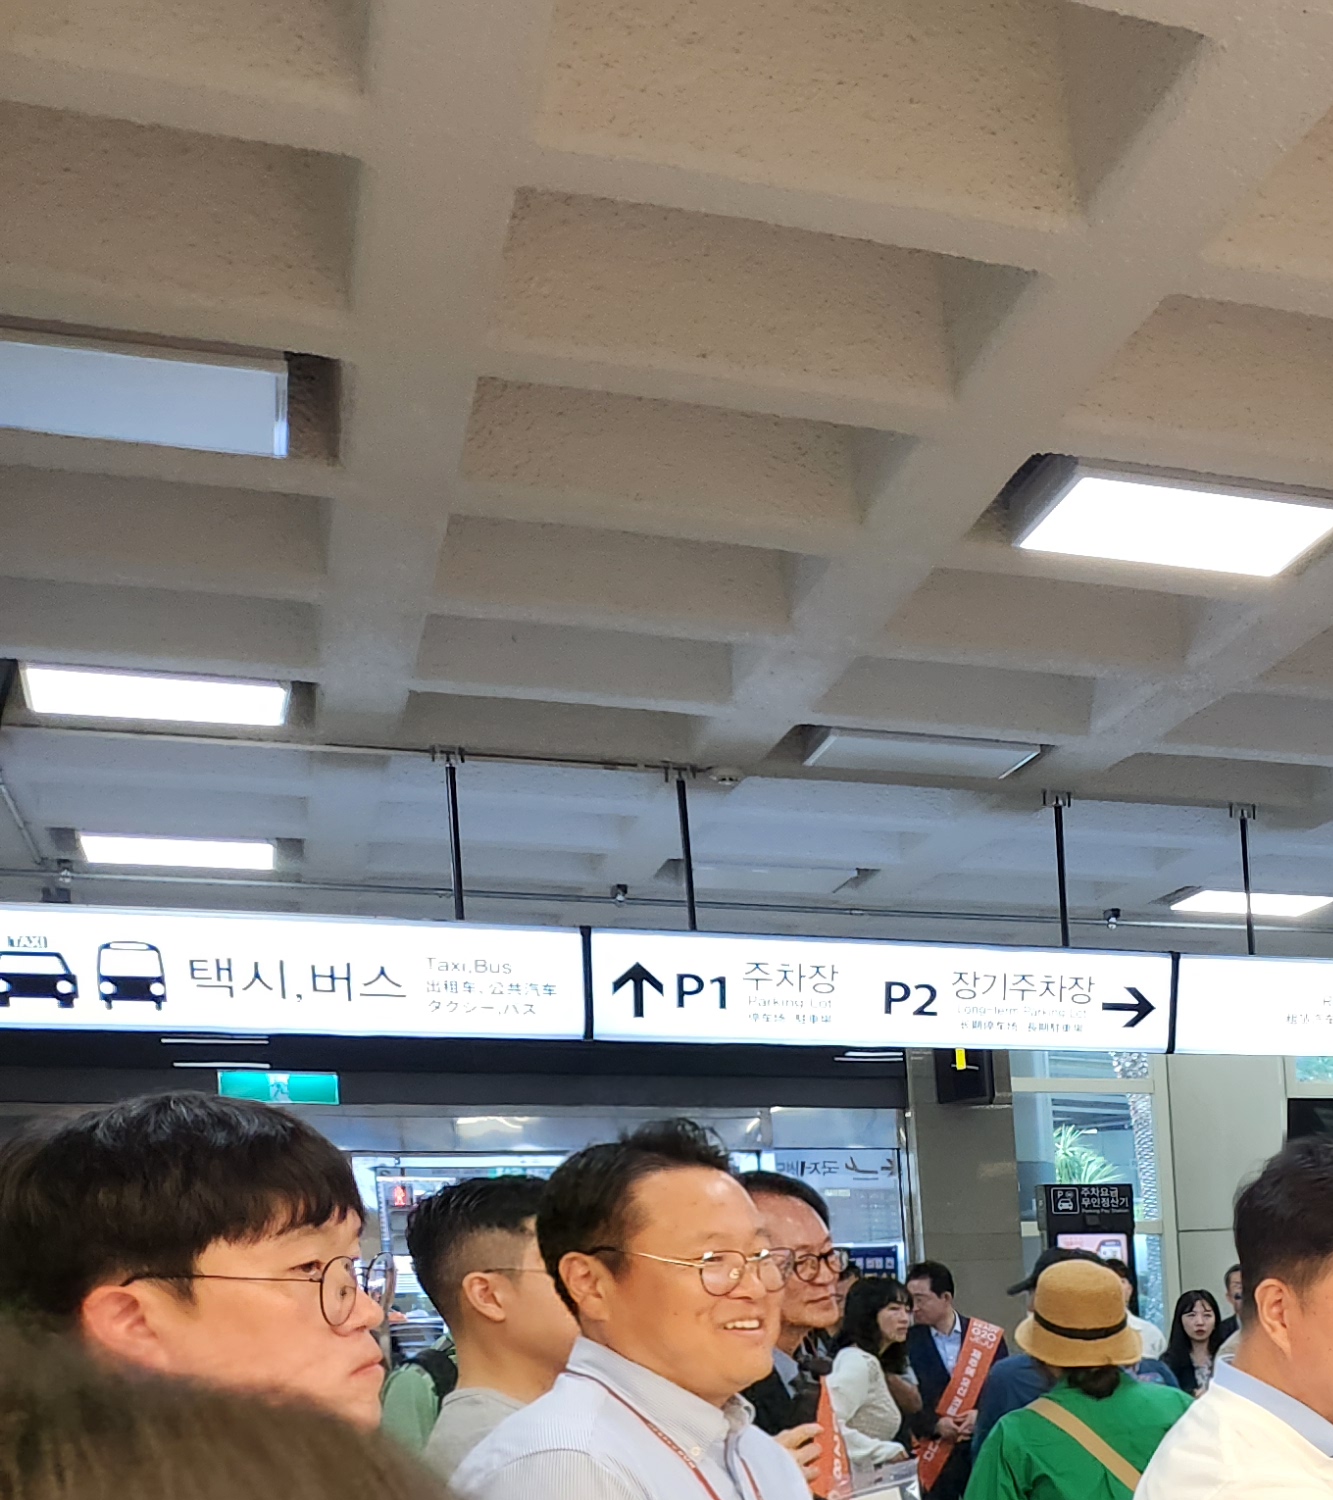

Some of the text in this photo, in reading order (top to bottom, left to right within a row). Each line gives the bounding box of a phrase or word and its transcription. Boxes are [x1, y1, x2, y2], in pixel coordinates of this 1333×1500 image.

[188, 957, 407, 1002] 택시,버스
[676, 973, 727, 1010] P1
[742, 962, 839, 994] 주차장
[951, 971, 1096, 1005] 장기주차장
[883, 981, 938, 1016] P2
[1080, 1187, 1119, 1198] 주차요금
